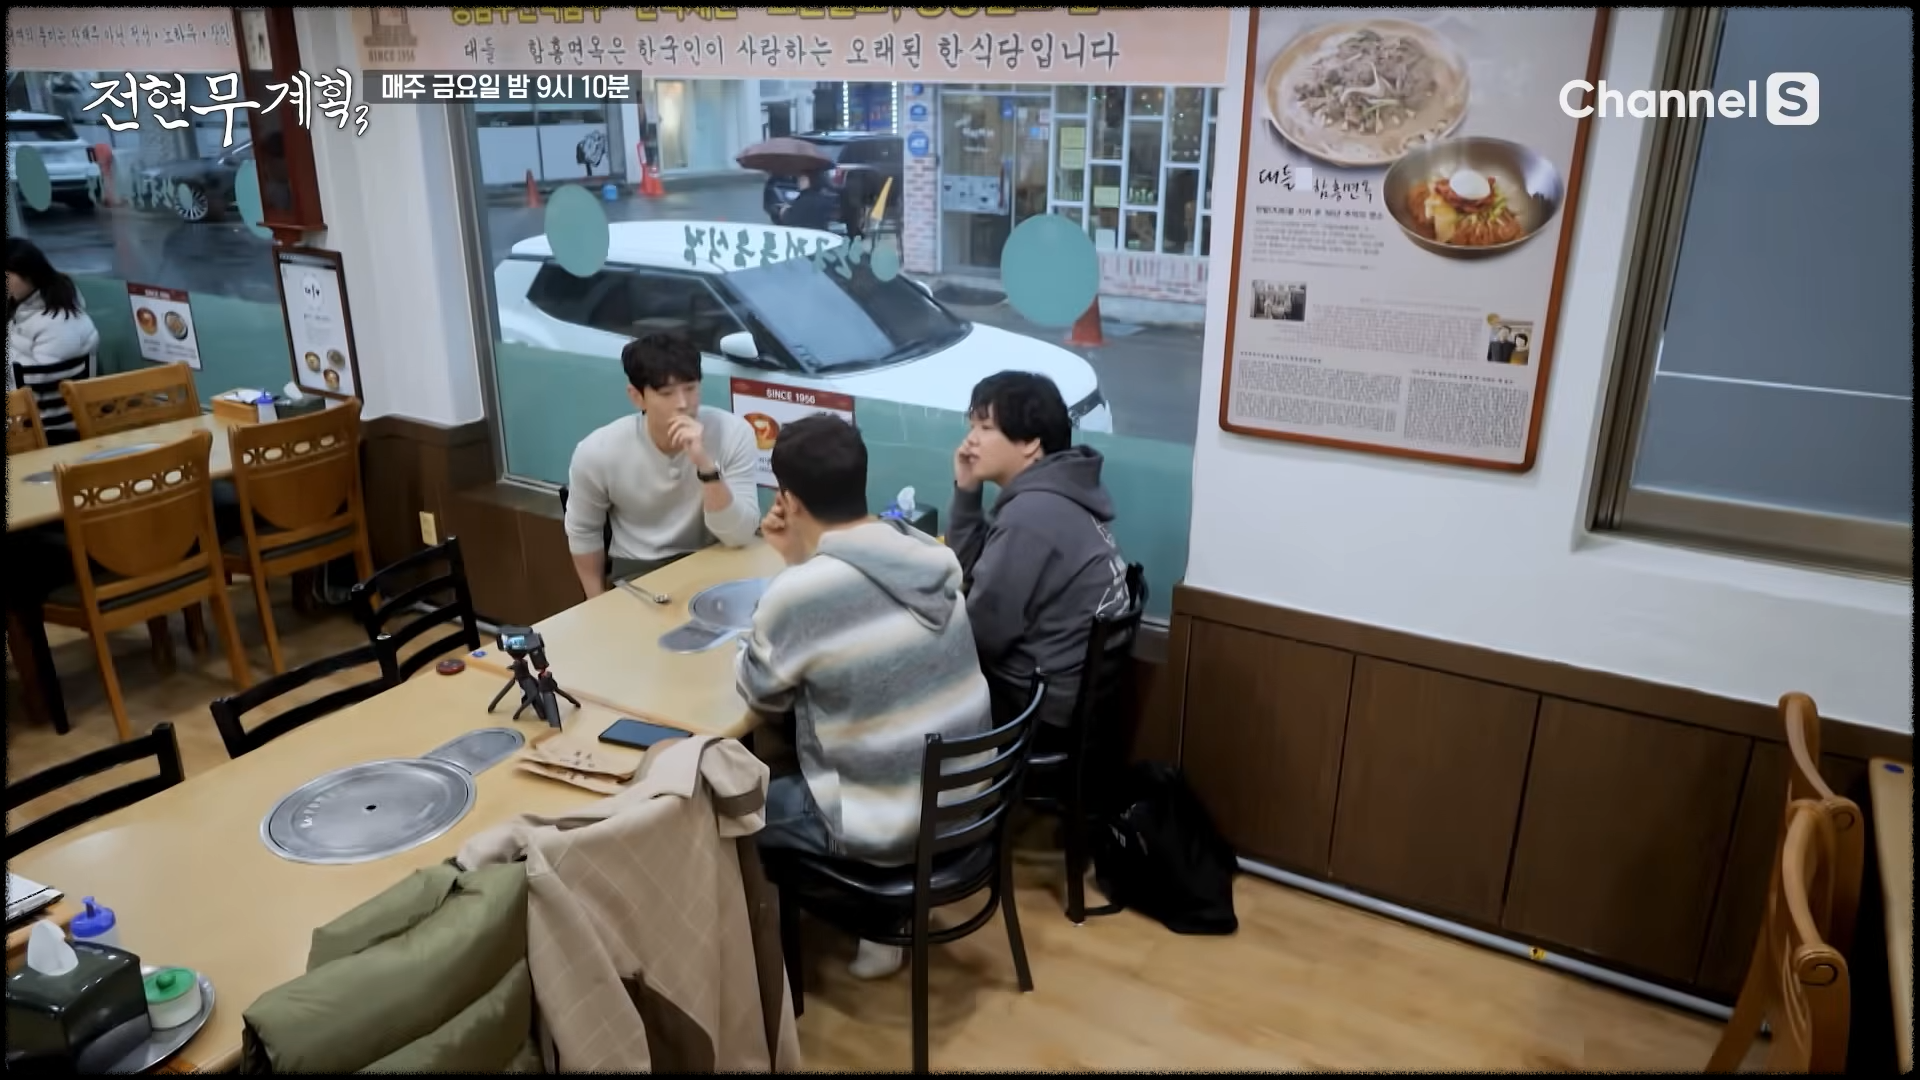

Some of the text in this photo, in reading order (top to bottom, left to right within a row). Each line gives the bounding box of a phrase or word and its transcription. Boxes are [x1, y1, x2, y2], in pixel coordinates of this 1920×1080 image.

[368, 49, 395, 63] SINCE
[528, 35, 627, 66] 함흥면옥은
[638, 34, 724, 67] 한국인이
[736, 34, 833, 67] 사랑하는
[846, 32, 922, 69] 오래된
[938, 31, 1120, 71] 한식당입니다
[1312, 177, 1373, 204] 함흥면옥
[766, 388, 792, 401] SINCE
